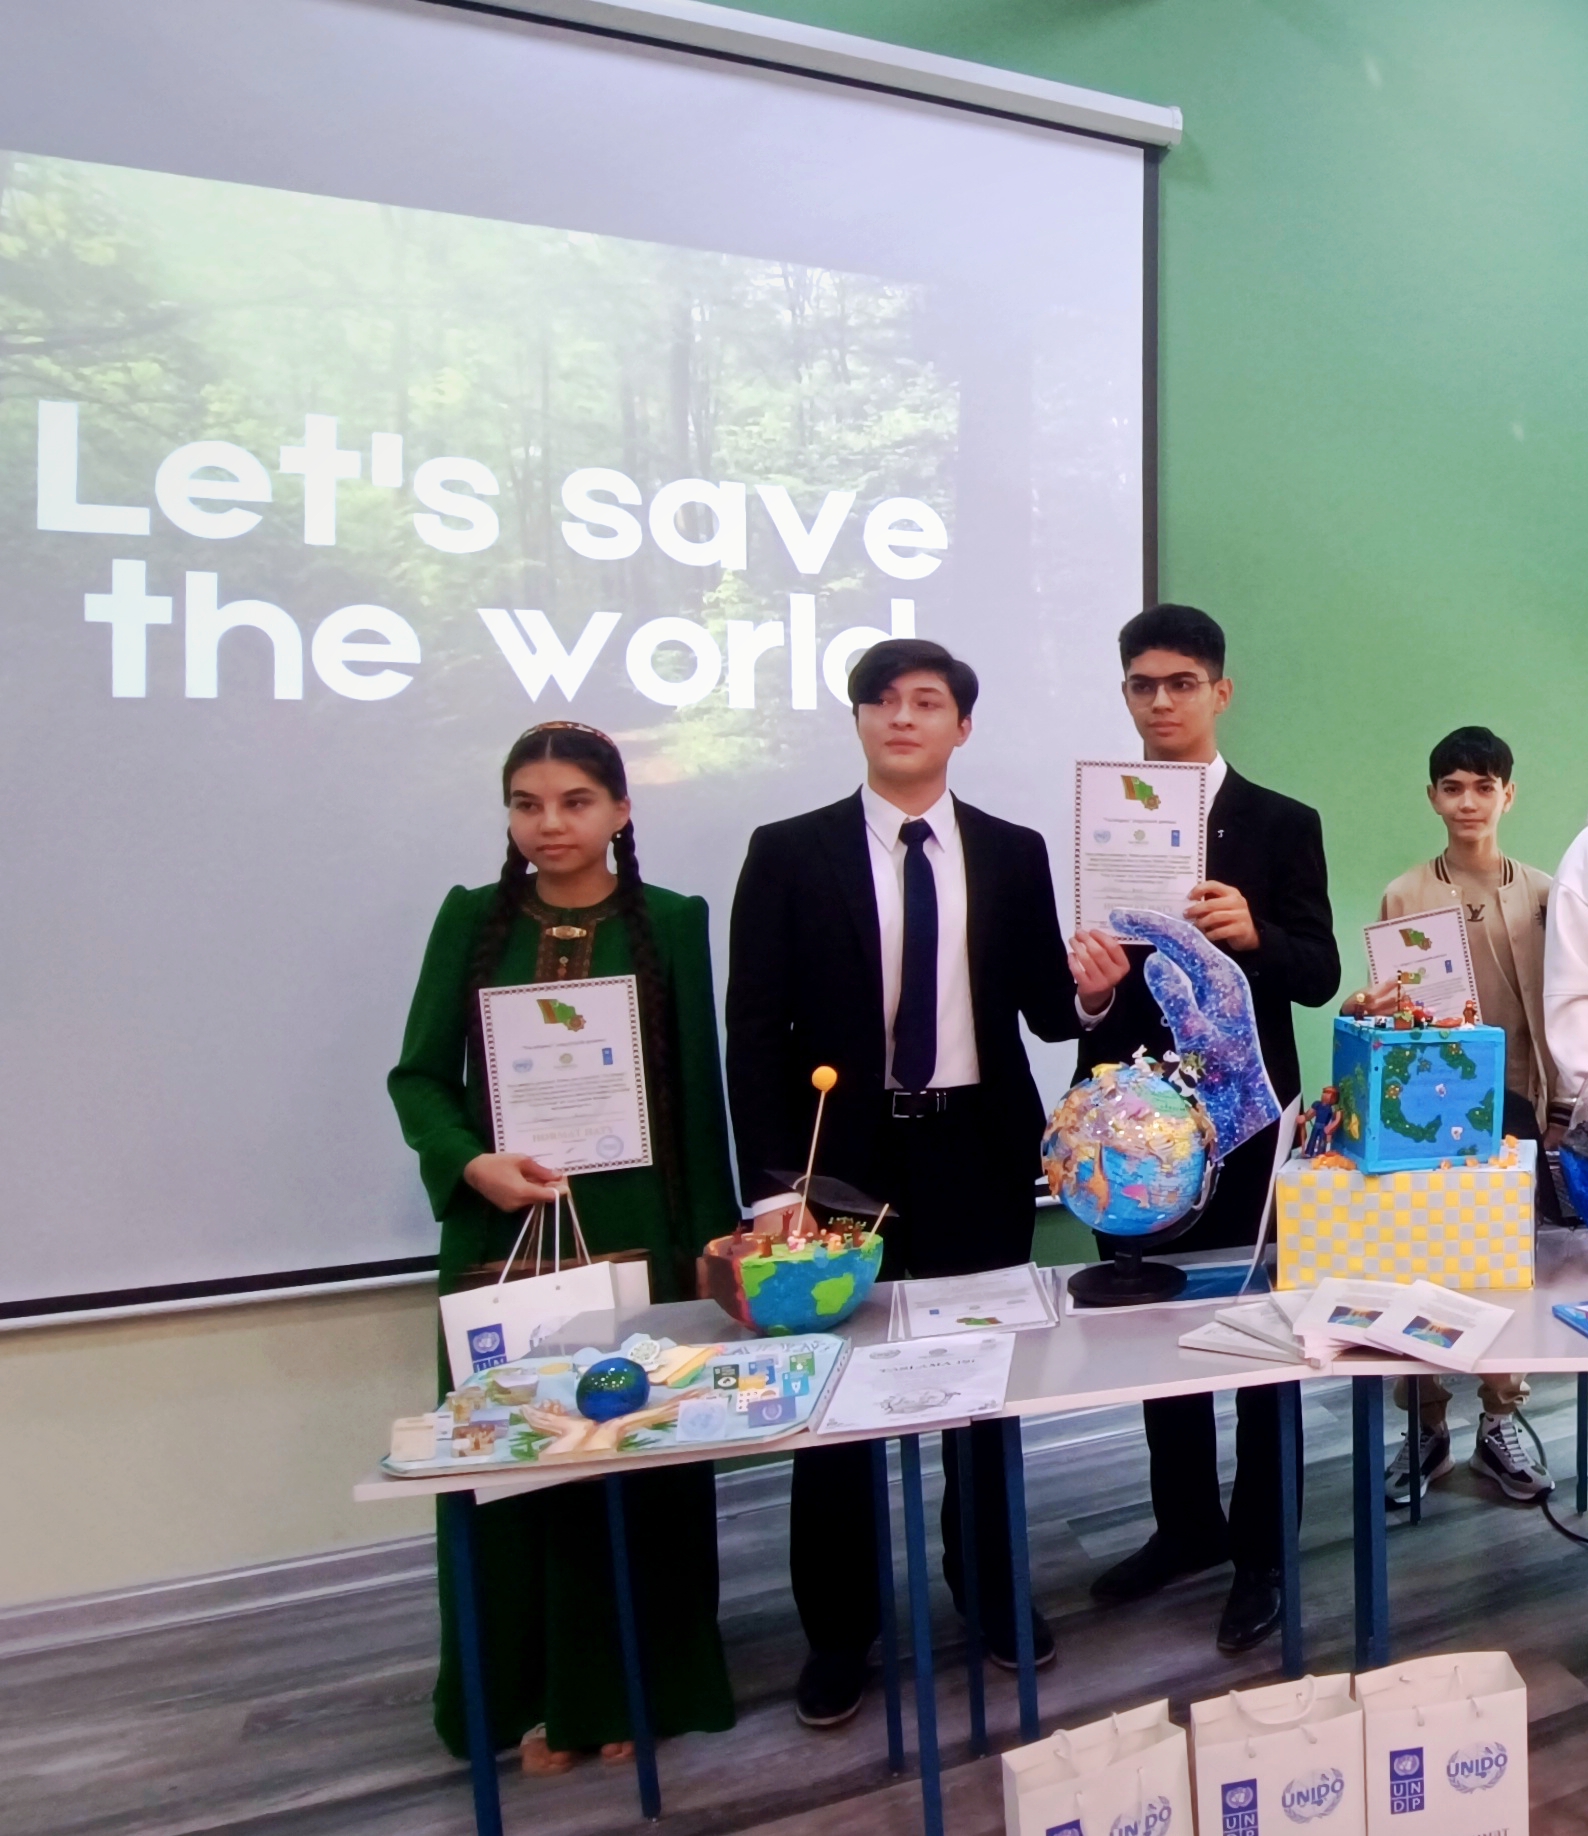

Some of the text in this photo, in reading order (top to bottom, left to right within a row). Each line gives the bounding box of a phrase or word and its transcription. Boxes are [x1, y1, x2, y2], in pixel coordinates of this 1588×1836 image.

[37, 402, 949, 580] Let's save
[84, 559, 916, 711] the world
[1281, 1778, 1345, 1809] UNIDO
[1447, 1753, 1508, 1778] UNIDO
